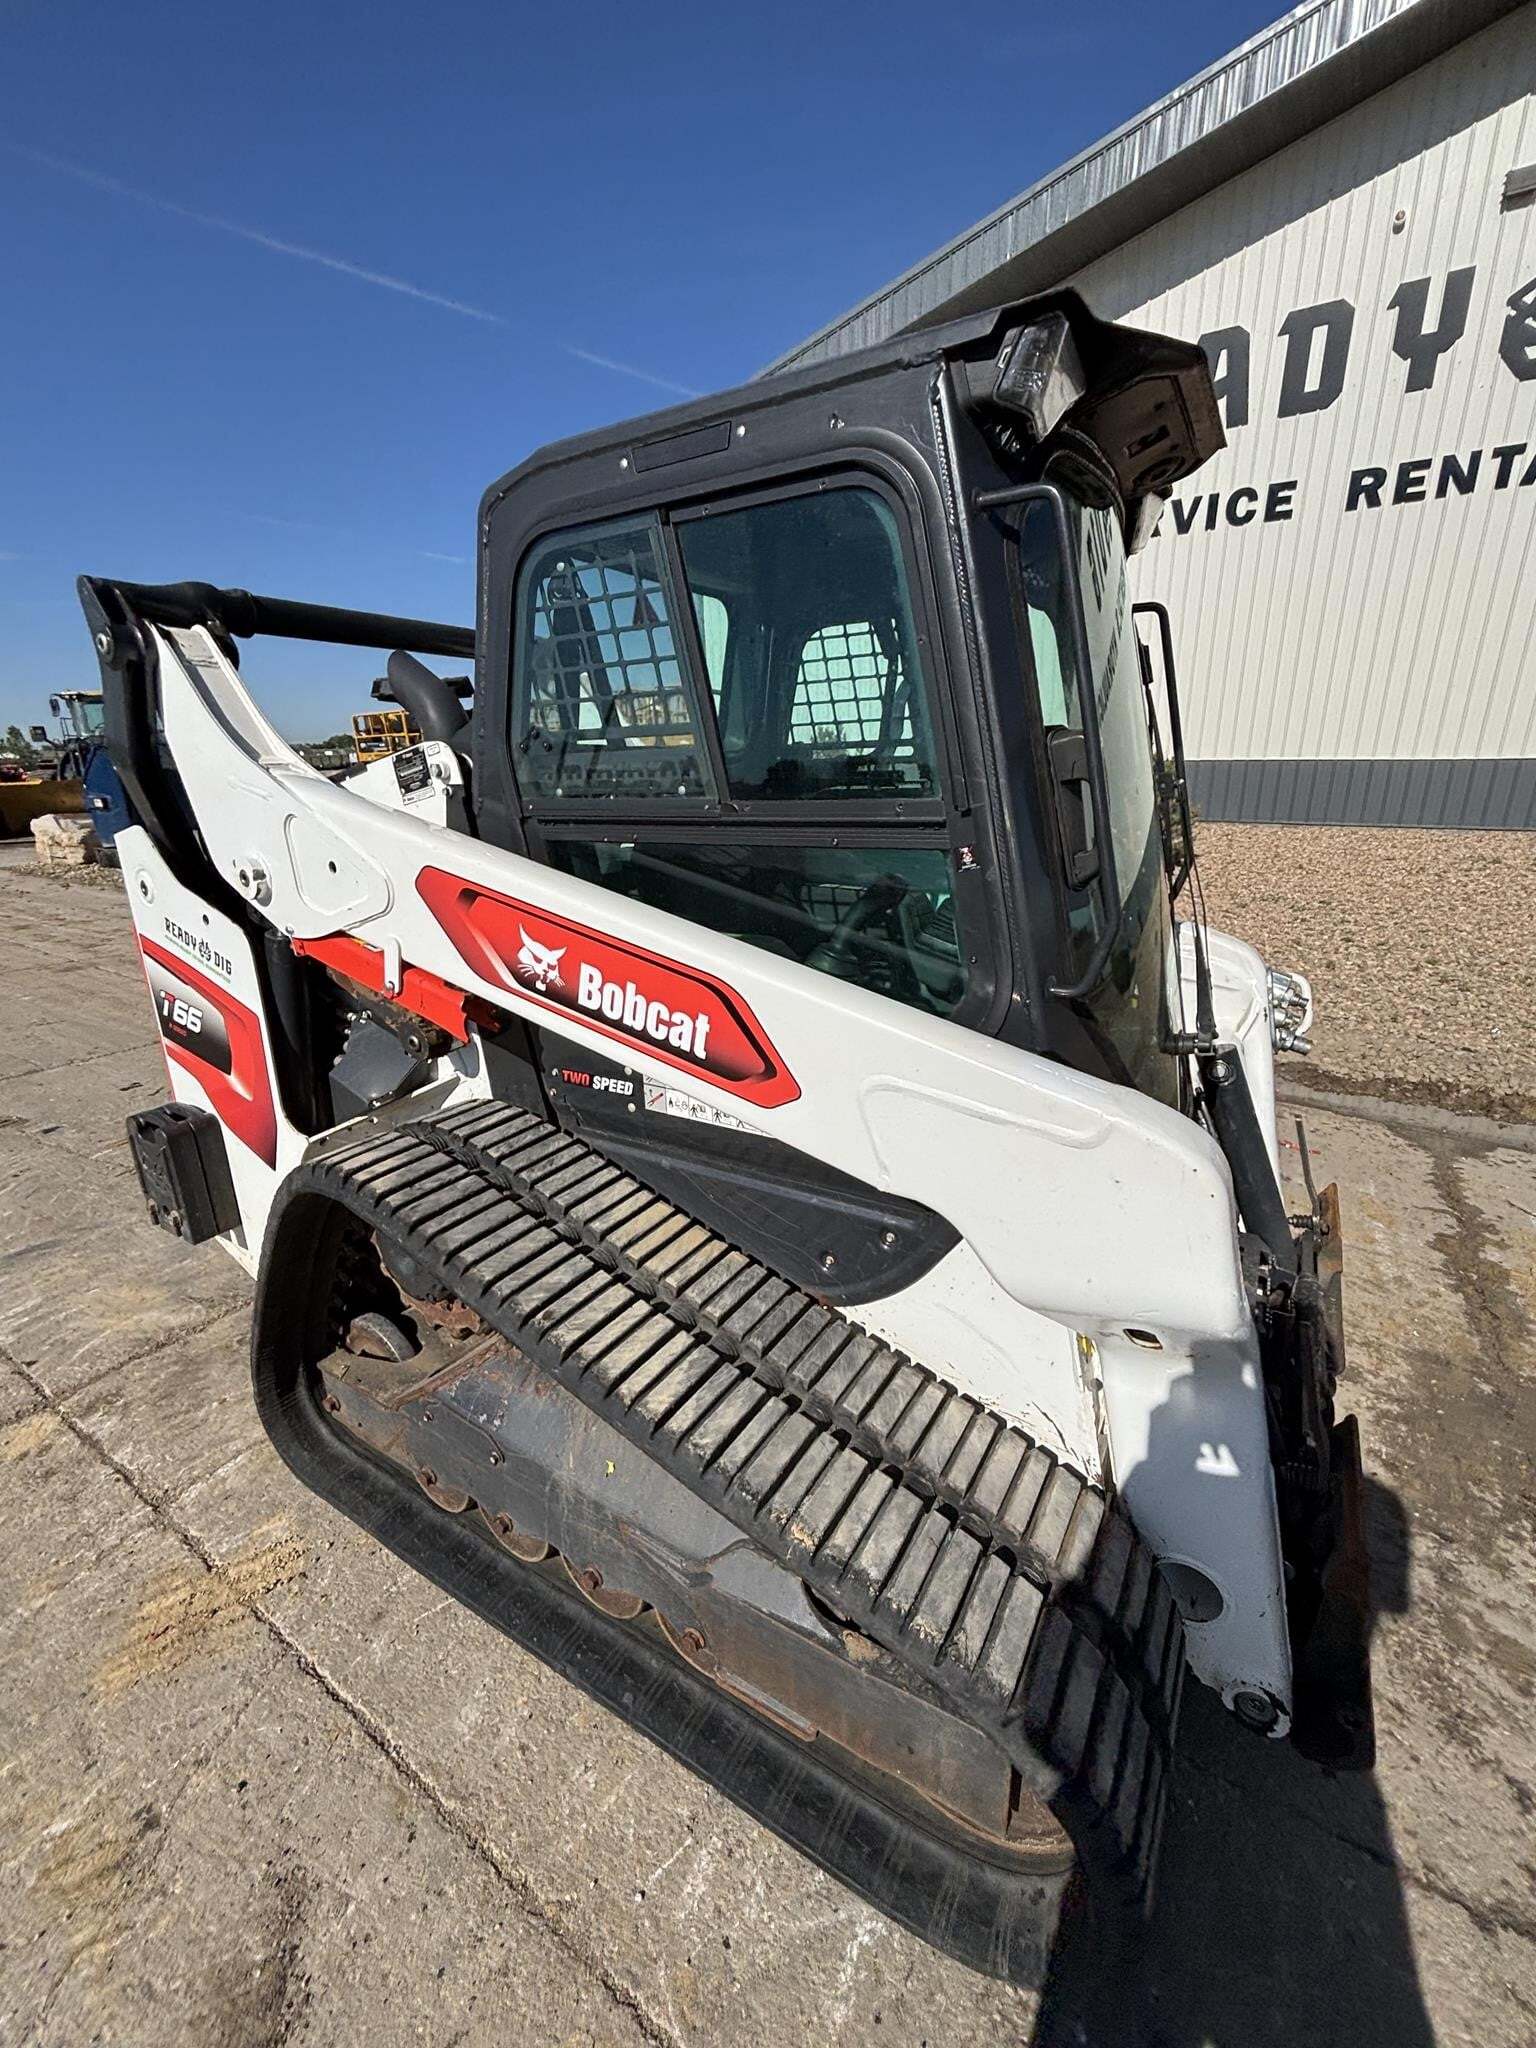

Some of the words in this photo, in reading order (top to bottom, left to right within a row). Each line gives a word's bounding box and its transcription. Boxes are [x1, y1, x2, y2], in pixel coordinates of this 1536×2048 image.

[1150, 480, 1298, 537] VICE
[164, 917, 197, 951] READY
[213, 951, 232, 975] DIG
[159, 989, 204, 1034] T66
[577, 961, 711, 1060] Bobcat
[562, 1068, 590, 1086] TWO
[592, 1075, 634, 1096] SPEED
